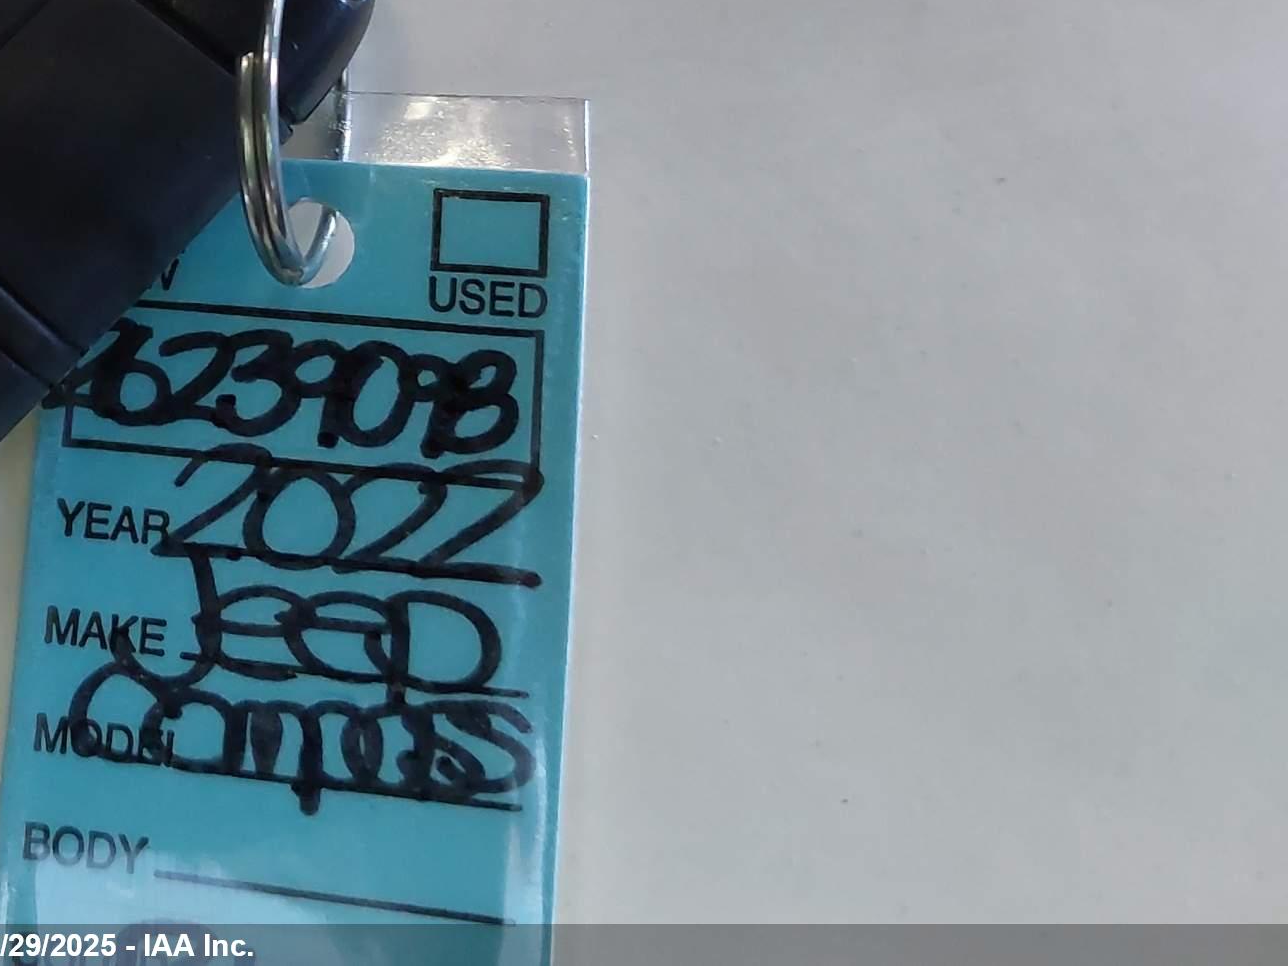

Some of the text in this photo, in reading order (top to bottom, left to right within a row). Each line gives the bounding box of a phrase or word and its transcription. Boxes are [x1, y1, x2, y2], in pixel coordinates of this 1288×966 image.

[428, 276, 548, 319] USED
[57, 497, 171, 546] YEAR
[151, 443, 545, 588] 2022
[44, 605, 168, 657] MAKE
[21, 821, 150, 874] BODY
